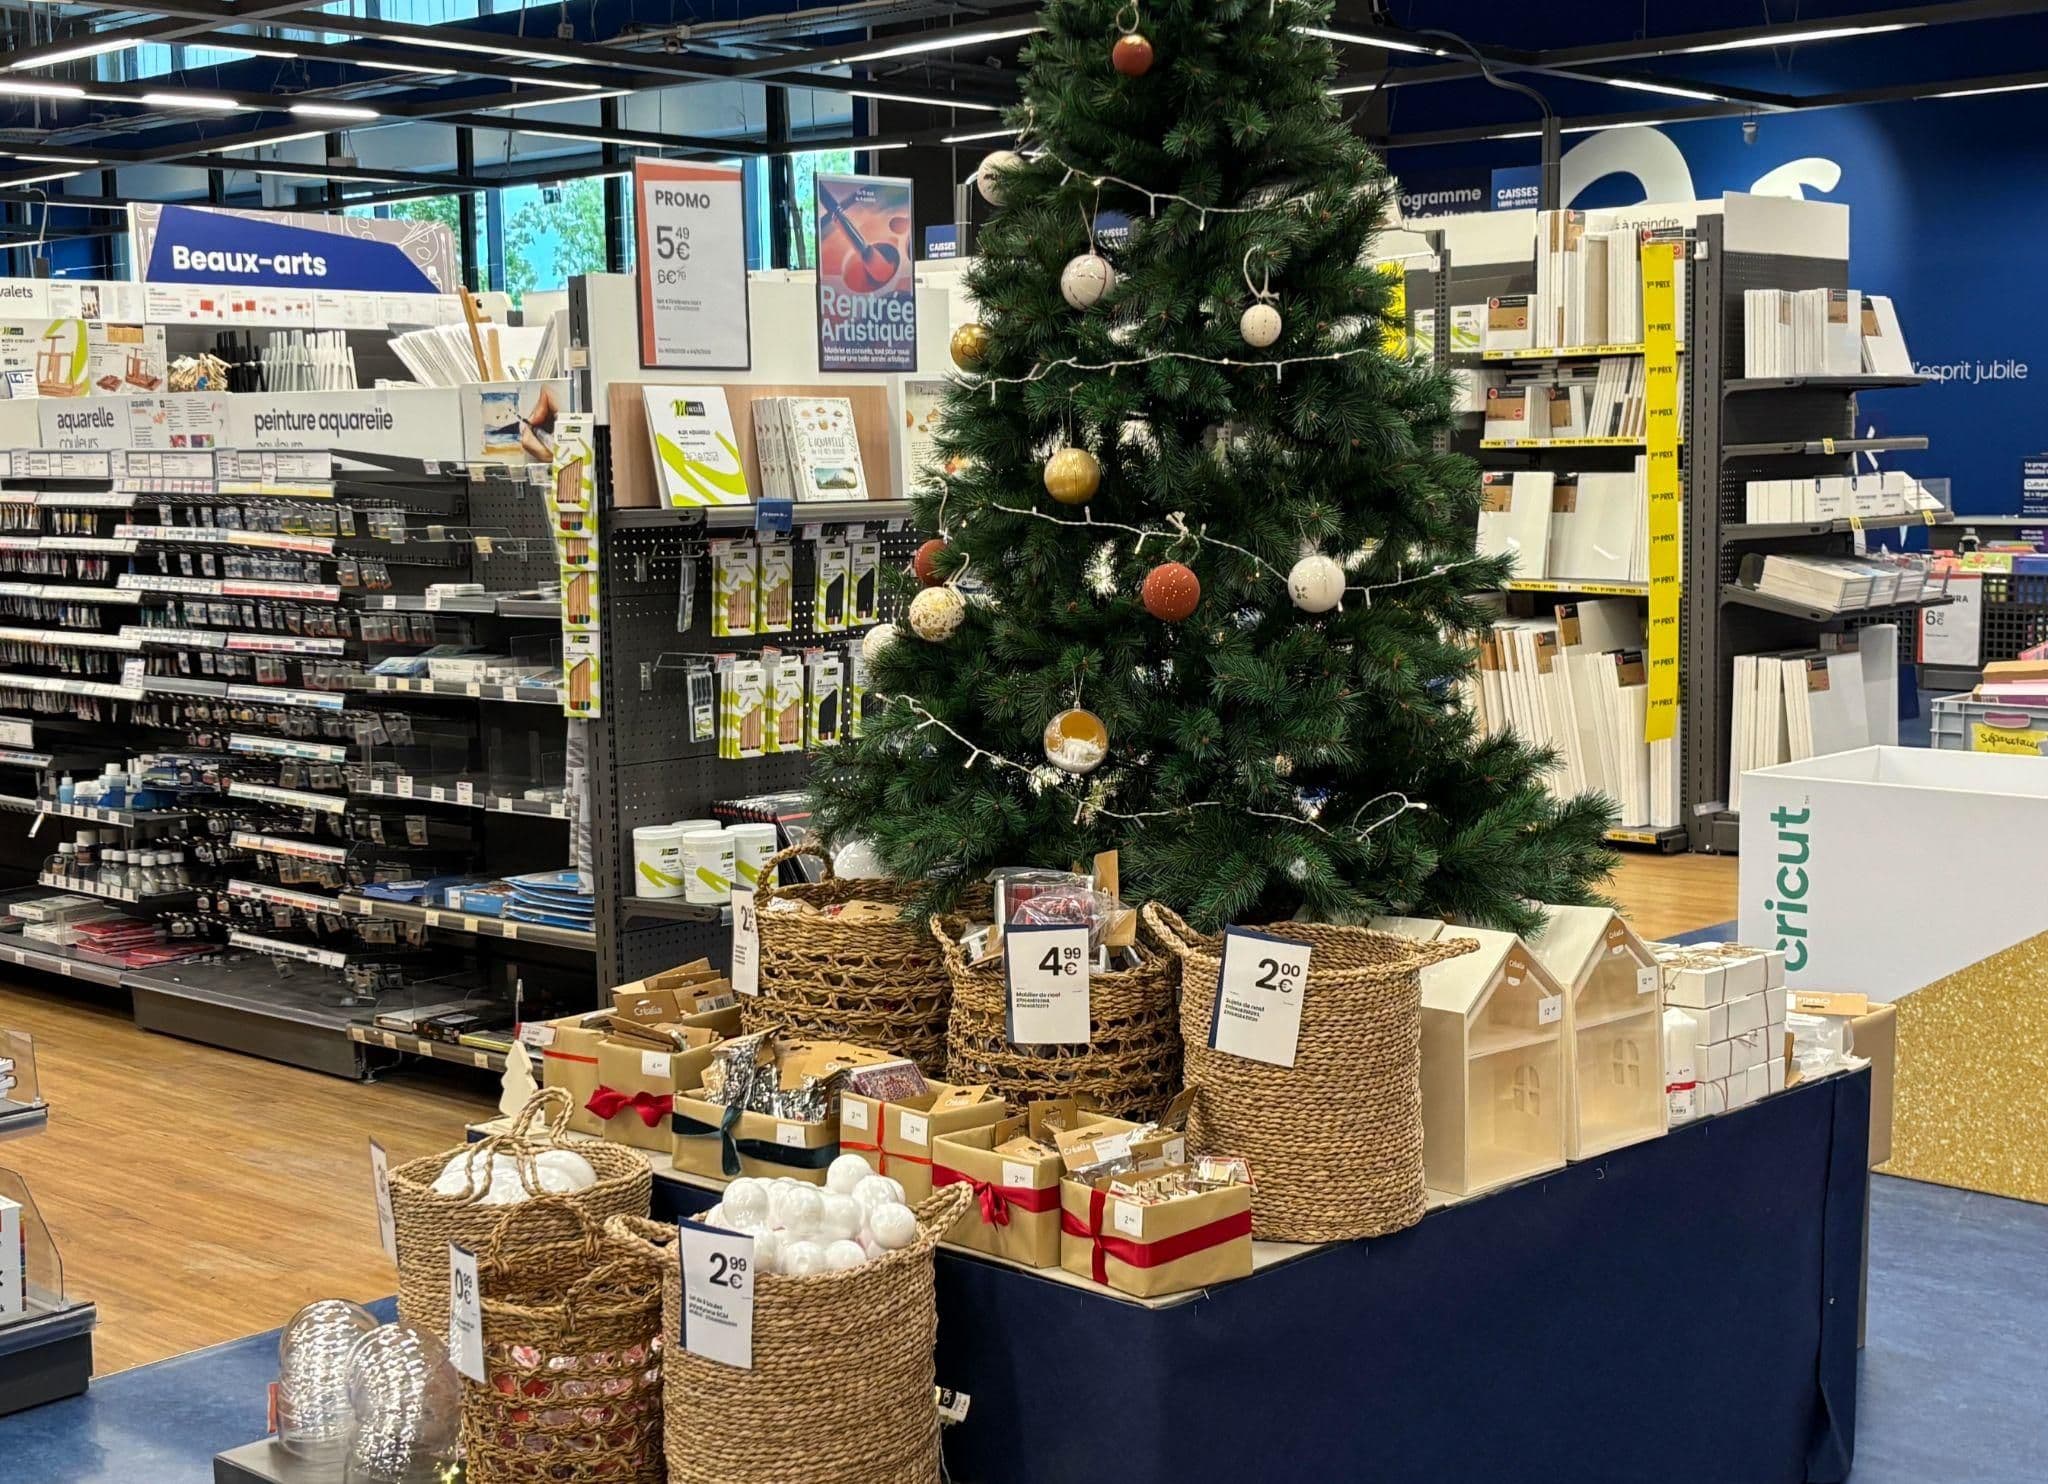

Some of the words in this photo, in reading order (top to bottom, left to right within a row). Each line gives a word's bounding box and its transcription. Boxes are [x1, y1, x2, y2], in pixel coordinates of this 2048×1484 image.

[655, 190, 711, 209] PROMO
[1401, 188, 1482, 210] ogramme
[1497, 186, 1538, 199] CAISSES
[171, 244, 327, 277] Beaux-arts
[820, 285, 914, 324] Rentrée
[821, 318, 914, 347] Artistique
[1973, 359, 2028, 384] jubile
[57, 406, 115, 434] aquarelle
[254, 408, 316, 438] peinture
[1925, 610, 1936, 626] 6
[1764, 805, 1811, 973] cricut
[1038, 946, 1063, 977] 4
[1255, 958, 1279, 991] 2
[709, 1252, 729, 1287] 2
